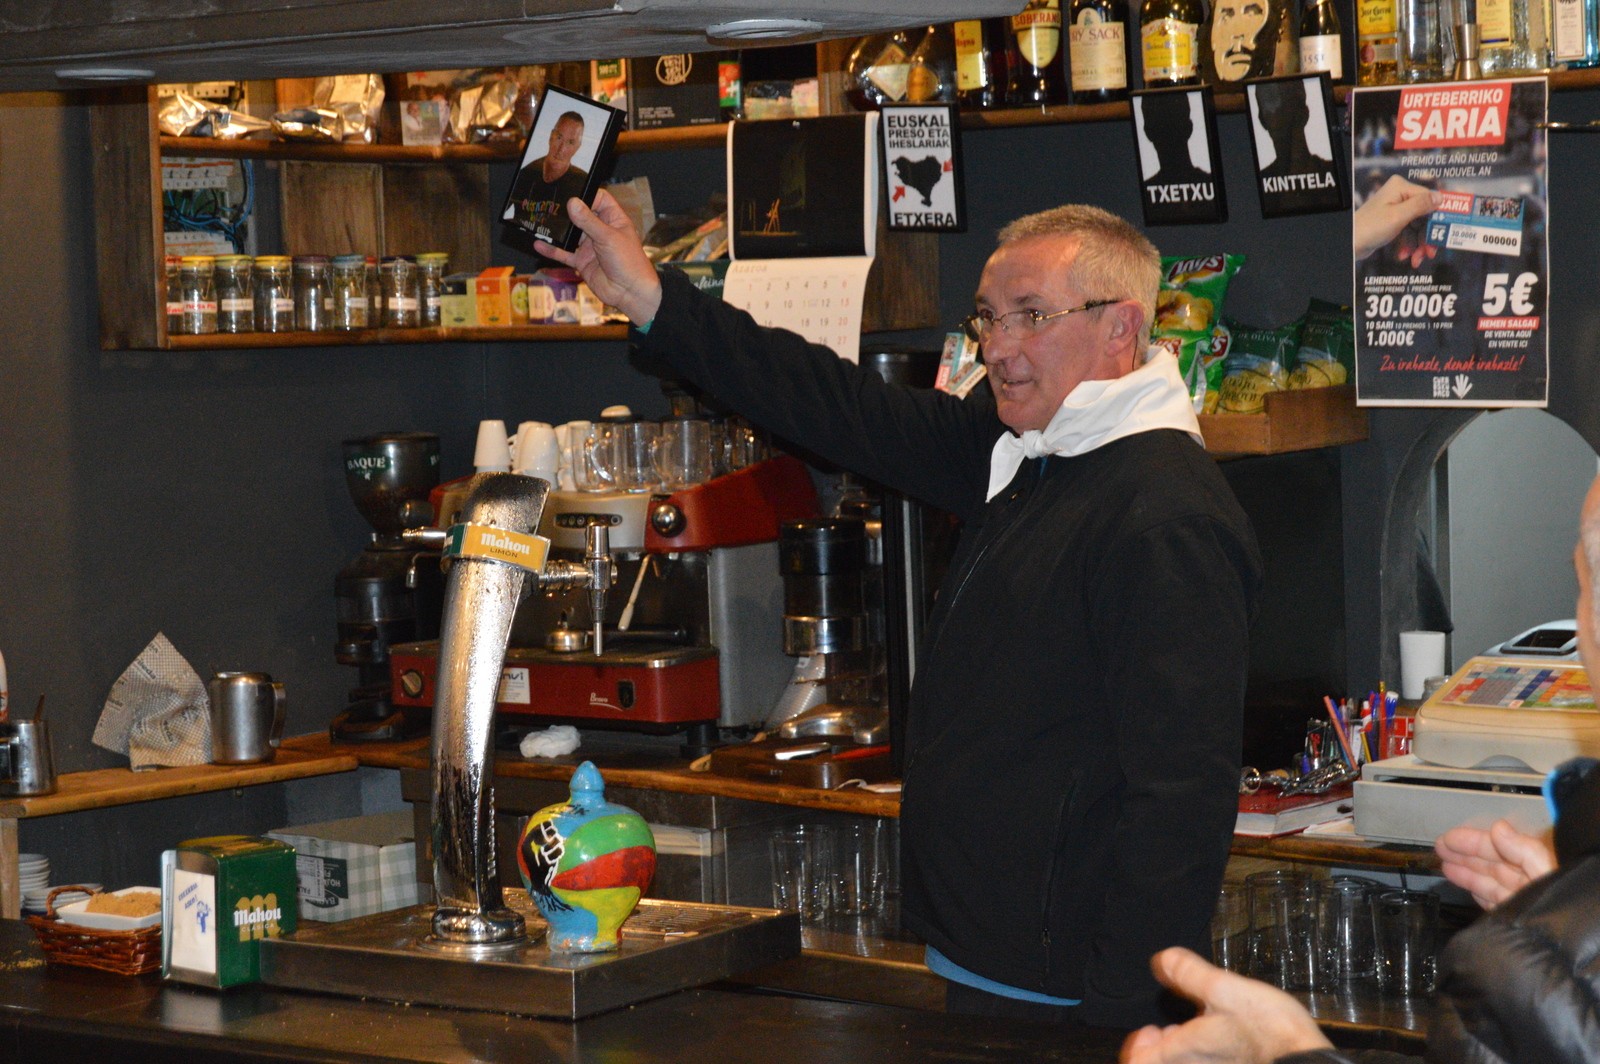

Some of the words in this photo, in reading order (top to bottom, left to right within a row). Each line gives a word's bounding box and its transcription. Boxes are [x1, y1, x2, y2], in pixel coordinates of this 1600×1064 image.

[1089, 27, 1121, 40] SACK
[1404, 88, 1503, 108] URTEBERRIKO
[887, 114, 950, 128] EUSKAL
[1400, 106, 1501, 141] SARIA
[888, 128, 925, 138] PRESO
[928, 128, 949, 138] ETA
[889, 139, 950, 148] IHESLARIAK
[1401, 155, 1433, 166] PREMIO
[1435, 154, 1447, 165] DE
[1449, 152, 1466, 164] AÑO
[1468, 152, 1498, 163] NUEVO
[1408, 168, 1429, 179] PRIX
[1430, 167, 1441, 178] DU
[1443, 166, 1476, 177] NOUVEL
[1478, 166, 1491, 176] AN
[1263, 172, 1336, 193] KINTTELA
[1147, 182, 1215, 203] TXETXU
[894, 212, 955, 226] ETXERA
[1482, 234, 1517, 246] 000000
[1364, 275, 1408, 286] LEHENENGO
[1409, 275, 1433, 284] SARIA
[1482, 272, 1539, 316] 5€
[821, 299, 830, 308] 12
[1365, 293, 1458, 318] 30.000€
[820, 318, 829, 327] 19
[838, 317, 848, 326] 20
[1366, 321, 1374, 330] 10
[1376, 321, 1394, 330] SARI
[1480, 319, 1506, 328] HEMEN
[1251, 333, 1276, 342] OLIVA
[1367, 330, 1415, 346] 1.000€
[1494, 330, 1514, 338] VENTA
[1488, 340, 1497, 348] EN
[1498, 340, 1518, 348] VENTE
[1519, 340, 1529, 348] ICI
[1443, 353, 1475, 371] denok
[481, 533, 530, 555] Mahou
[234, 907, 282, 927] Mahou
